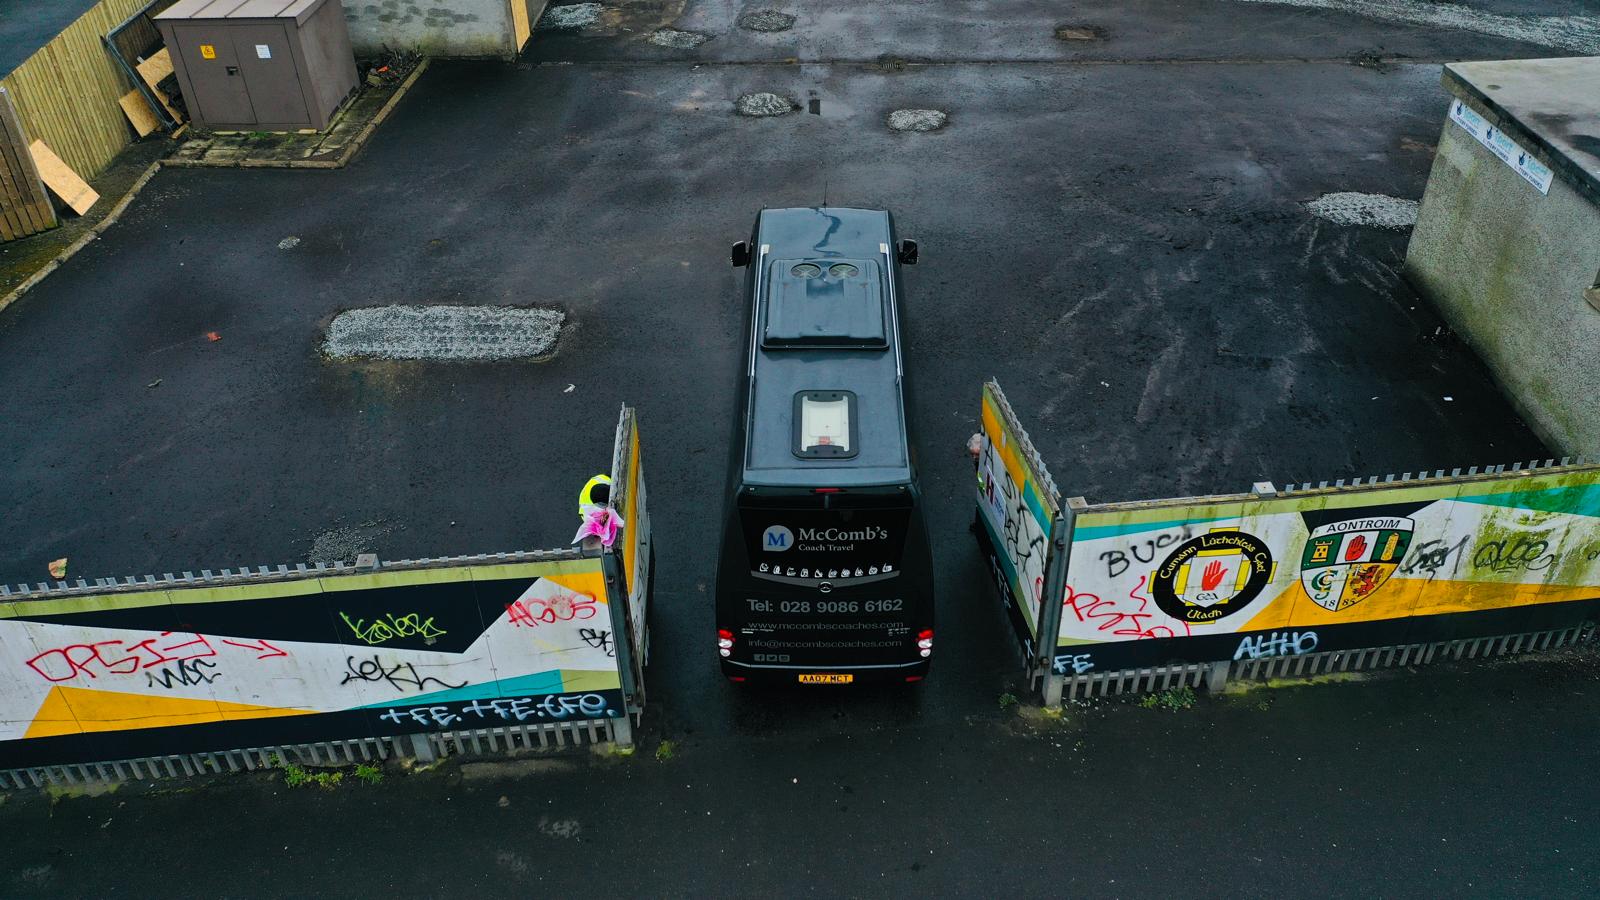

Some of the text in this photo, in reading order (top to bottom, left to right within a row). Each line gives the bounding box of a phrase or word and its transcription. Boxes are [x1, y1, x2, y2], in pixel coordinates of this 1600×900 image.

[1326, 519, 1401, 533] AONTROIM
[767, 532, 786, 547] M
[798, 526, 888, 541] McComb's
[798, 543, 854, 552] Coach Travel
[1160, 545, 1197, 579] Cumann
[746, 598, 904, 613] Tel: 028 9086 6162
[1186, 608, 1223, 619] Uladh
[748, 620, 904, 630] www.mccombscoaches.com
[748, 639, 902, 649] info@mccombscoaches.com
[802, 675, 849, 683] AA07 MCT
